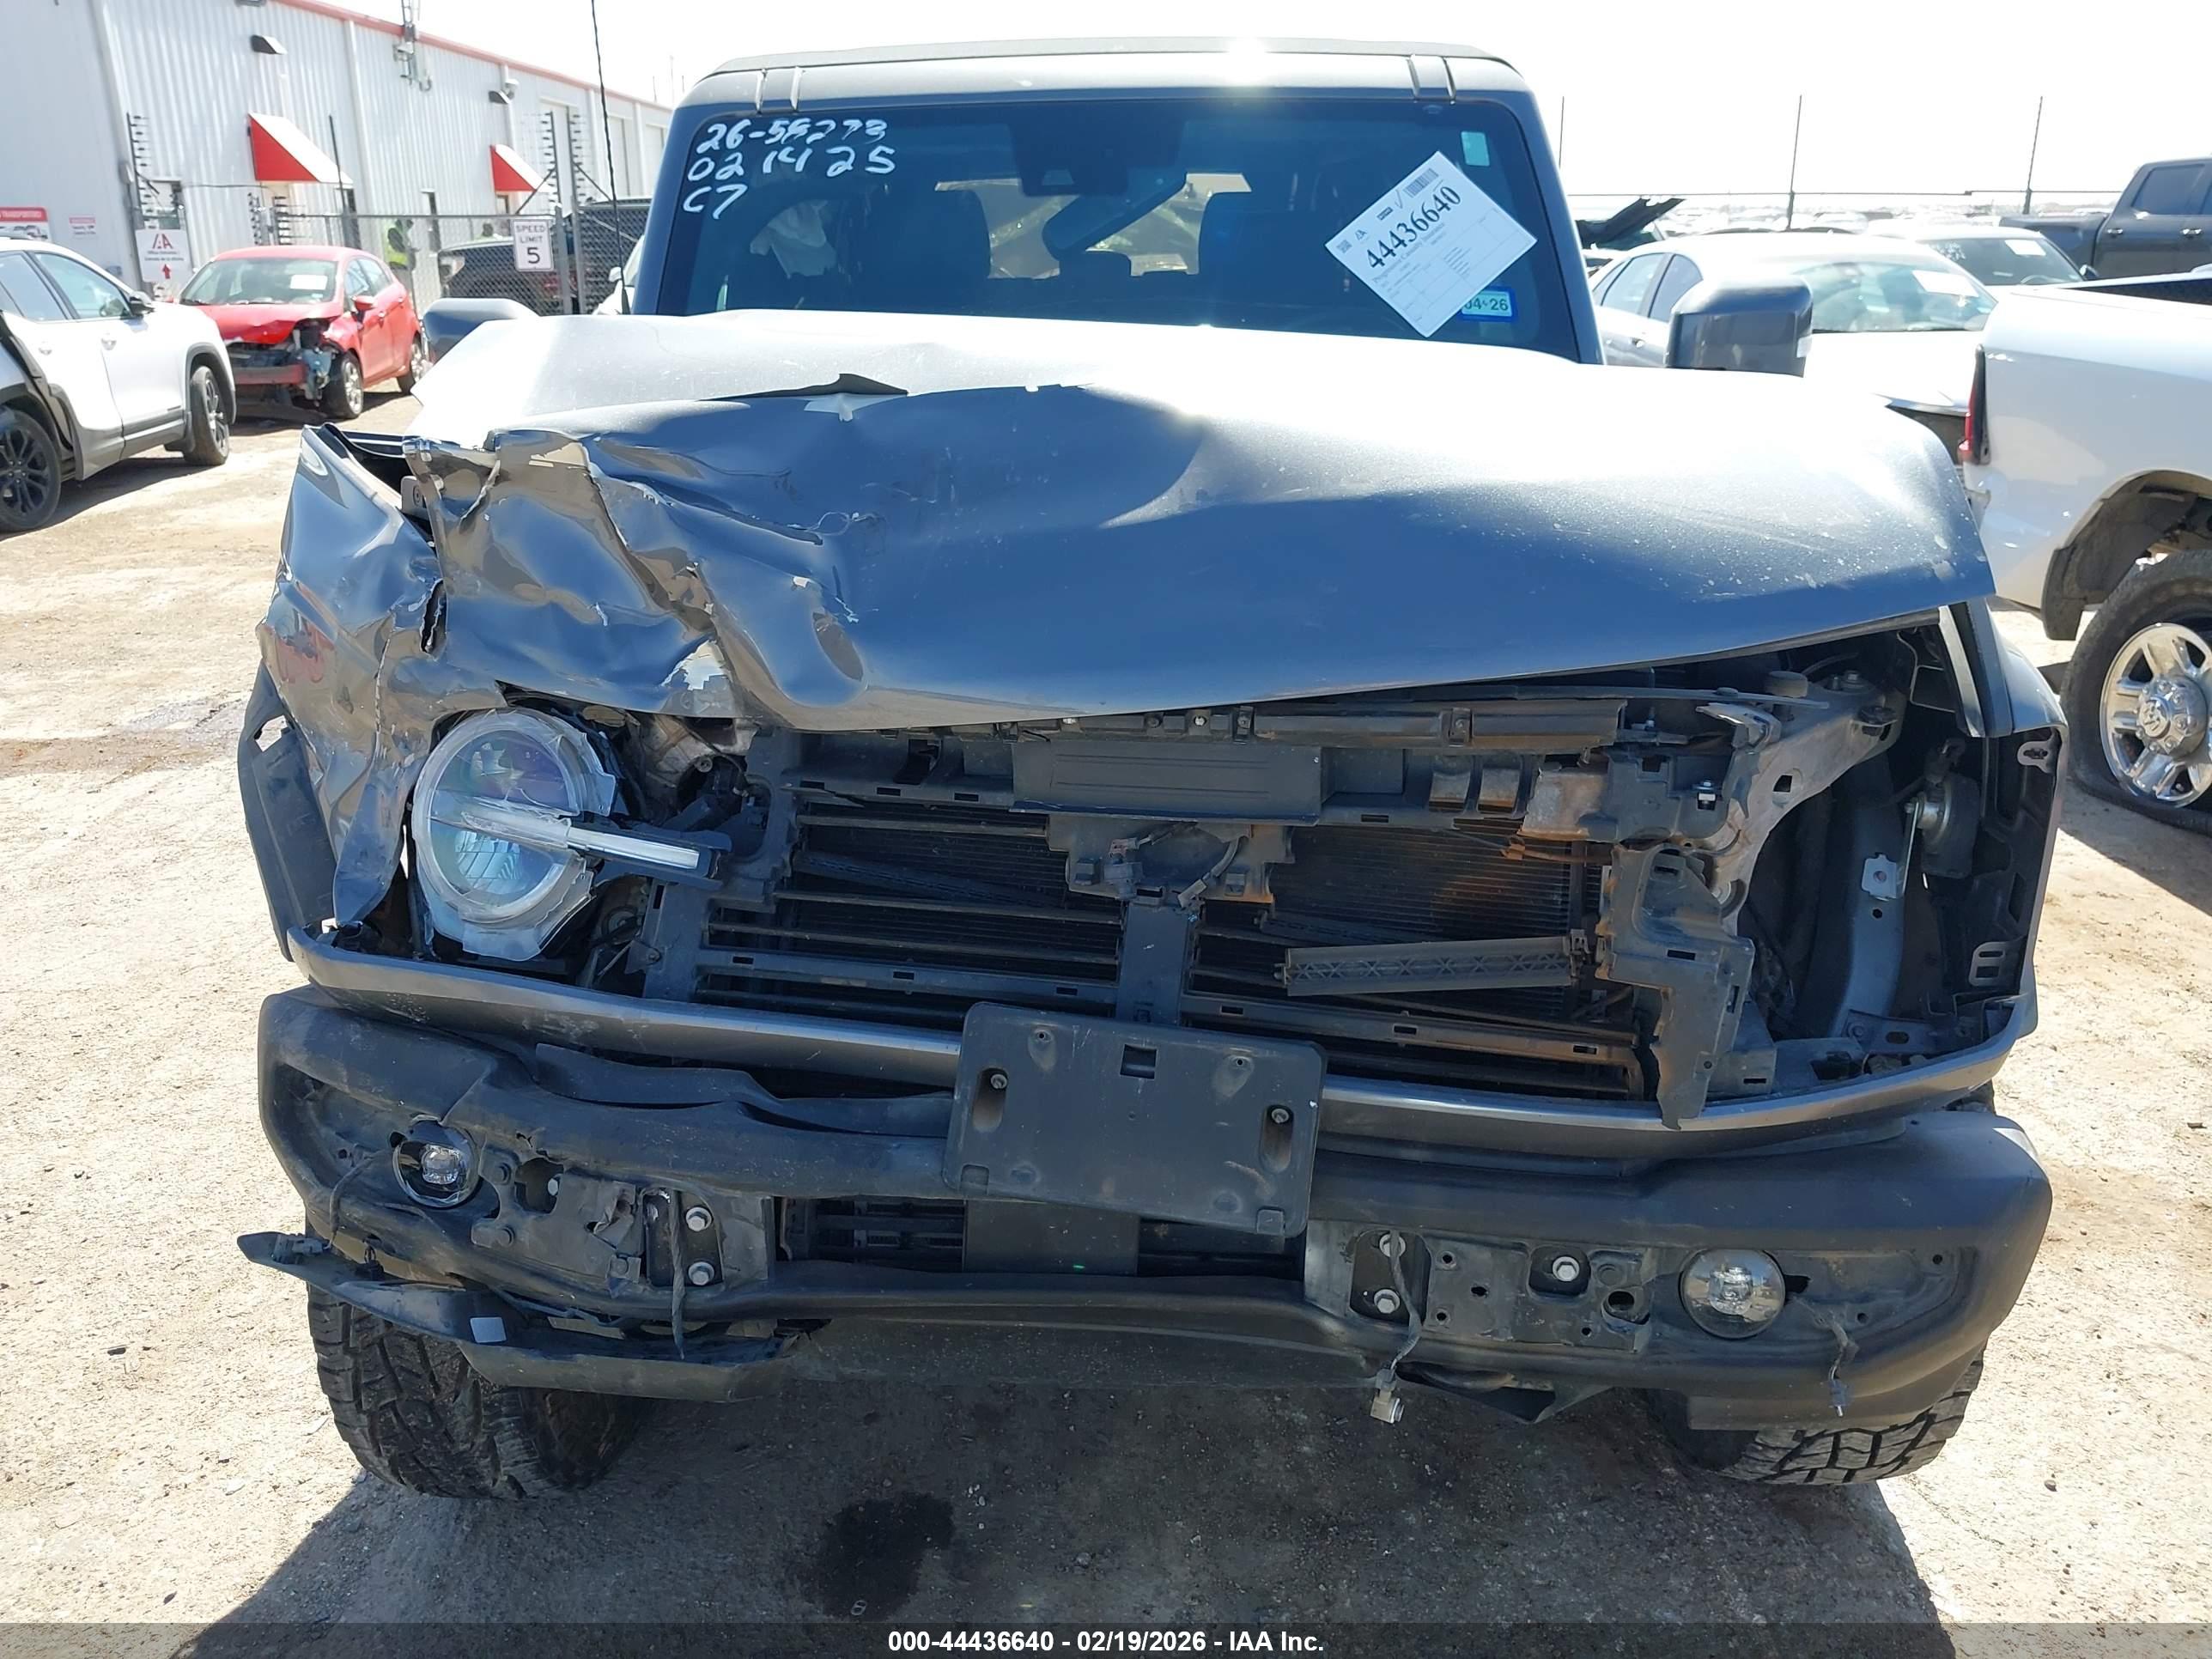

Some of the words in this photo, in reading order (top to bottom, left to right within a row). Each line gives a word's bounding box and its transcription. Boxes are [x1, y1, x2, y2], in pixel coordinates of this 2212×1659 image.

[516, 224, 544, 233] SPEED
[1366, 185, 1462, 269] 44436640
[526, 246, 541, 264] 5
[1490, 297, 1509, 311] 26
